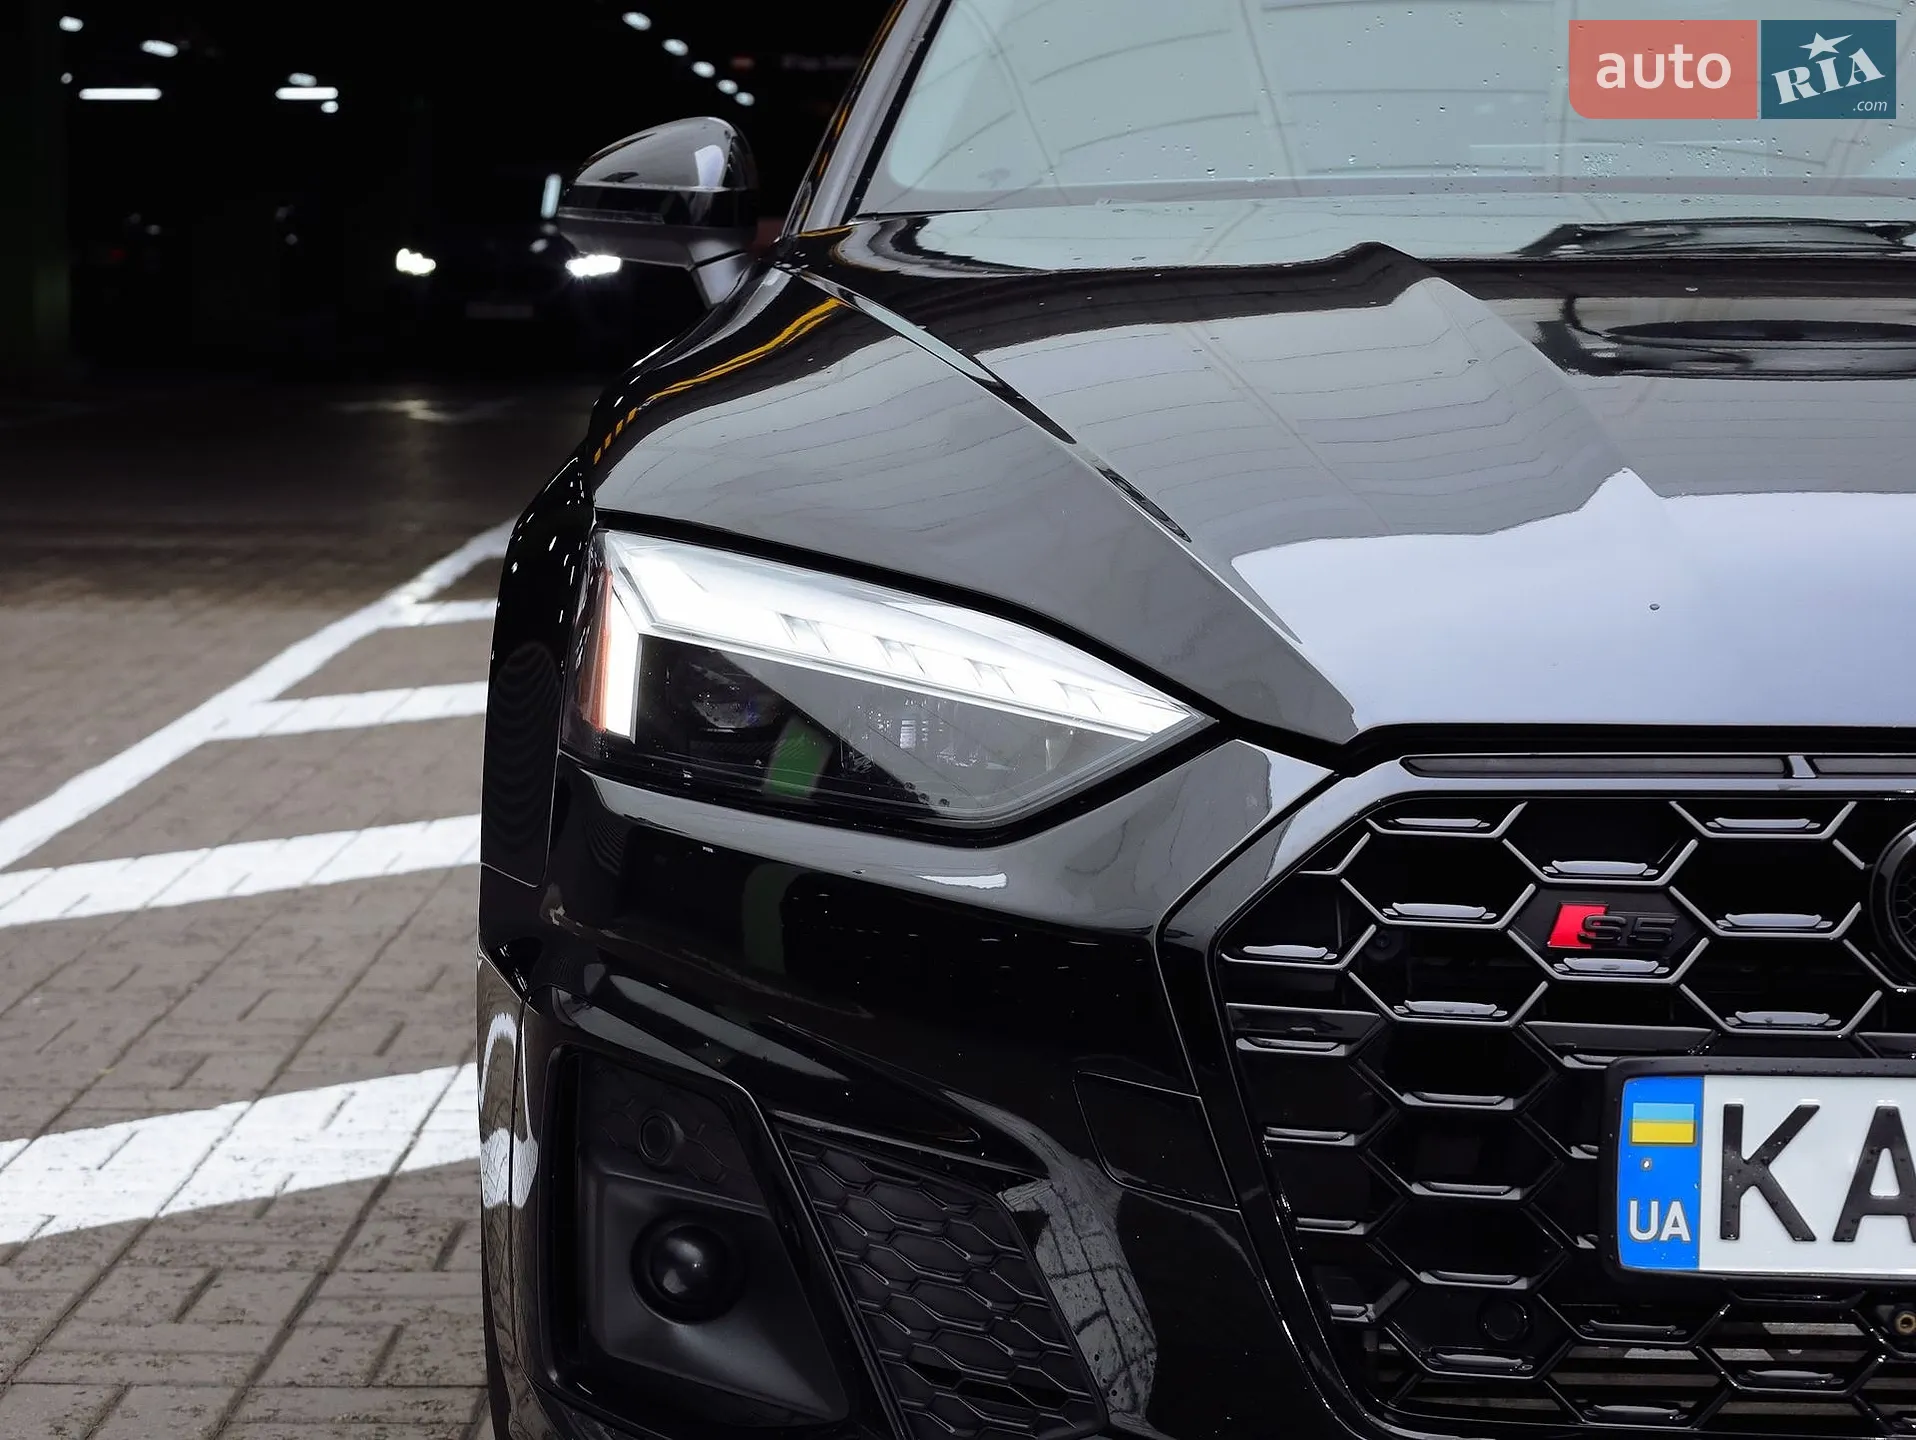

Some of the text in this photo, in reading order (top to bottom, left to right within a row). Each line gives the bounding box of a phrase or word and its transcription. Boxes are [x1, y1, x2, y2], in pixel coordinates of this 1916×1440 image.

[1576, 914, 1678, 943] S5
[1719, 1103, 1916, 1243] KA
[1628, 1200, 1692, 1242] UA
